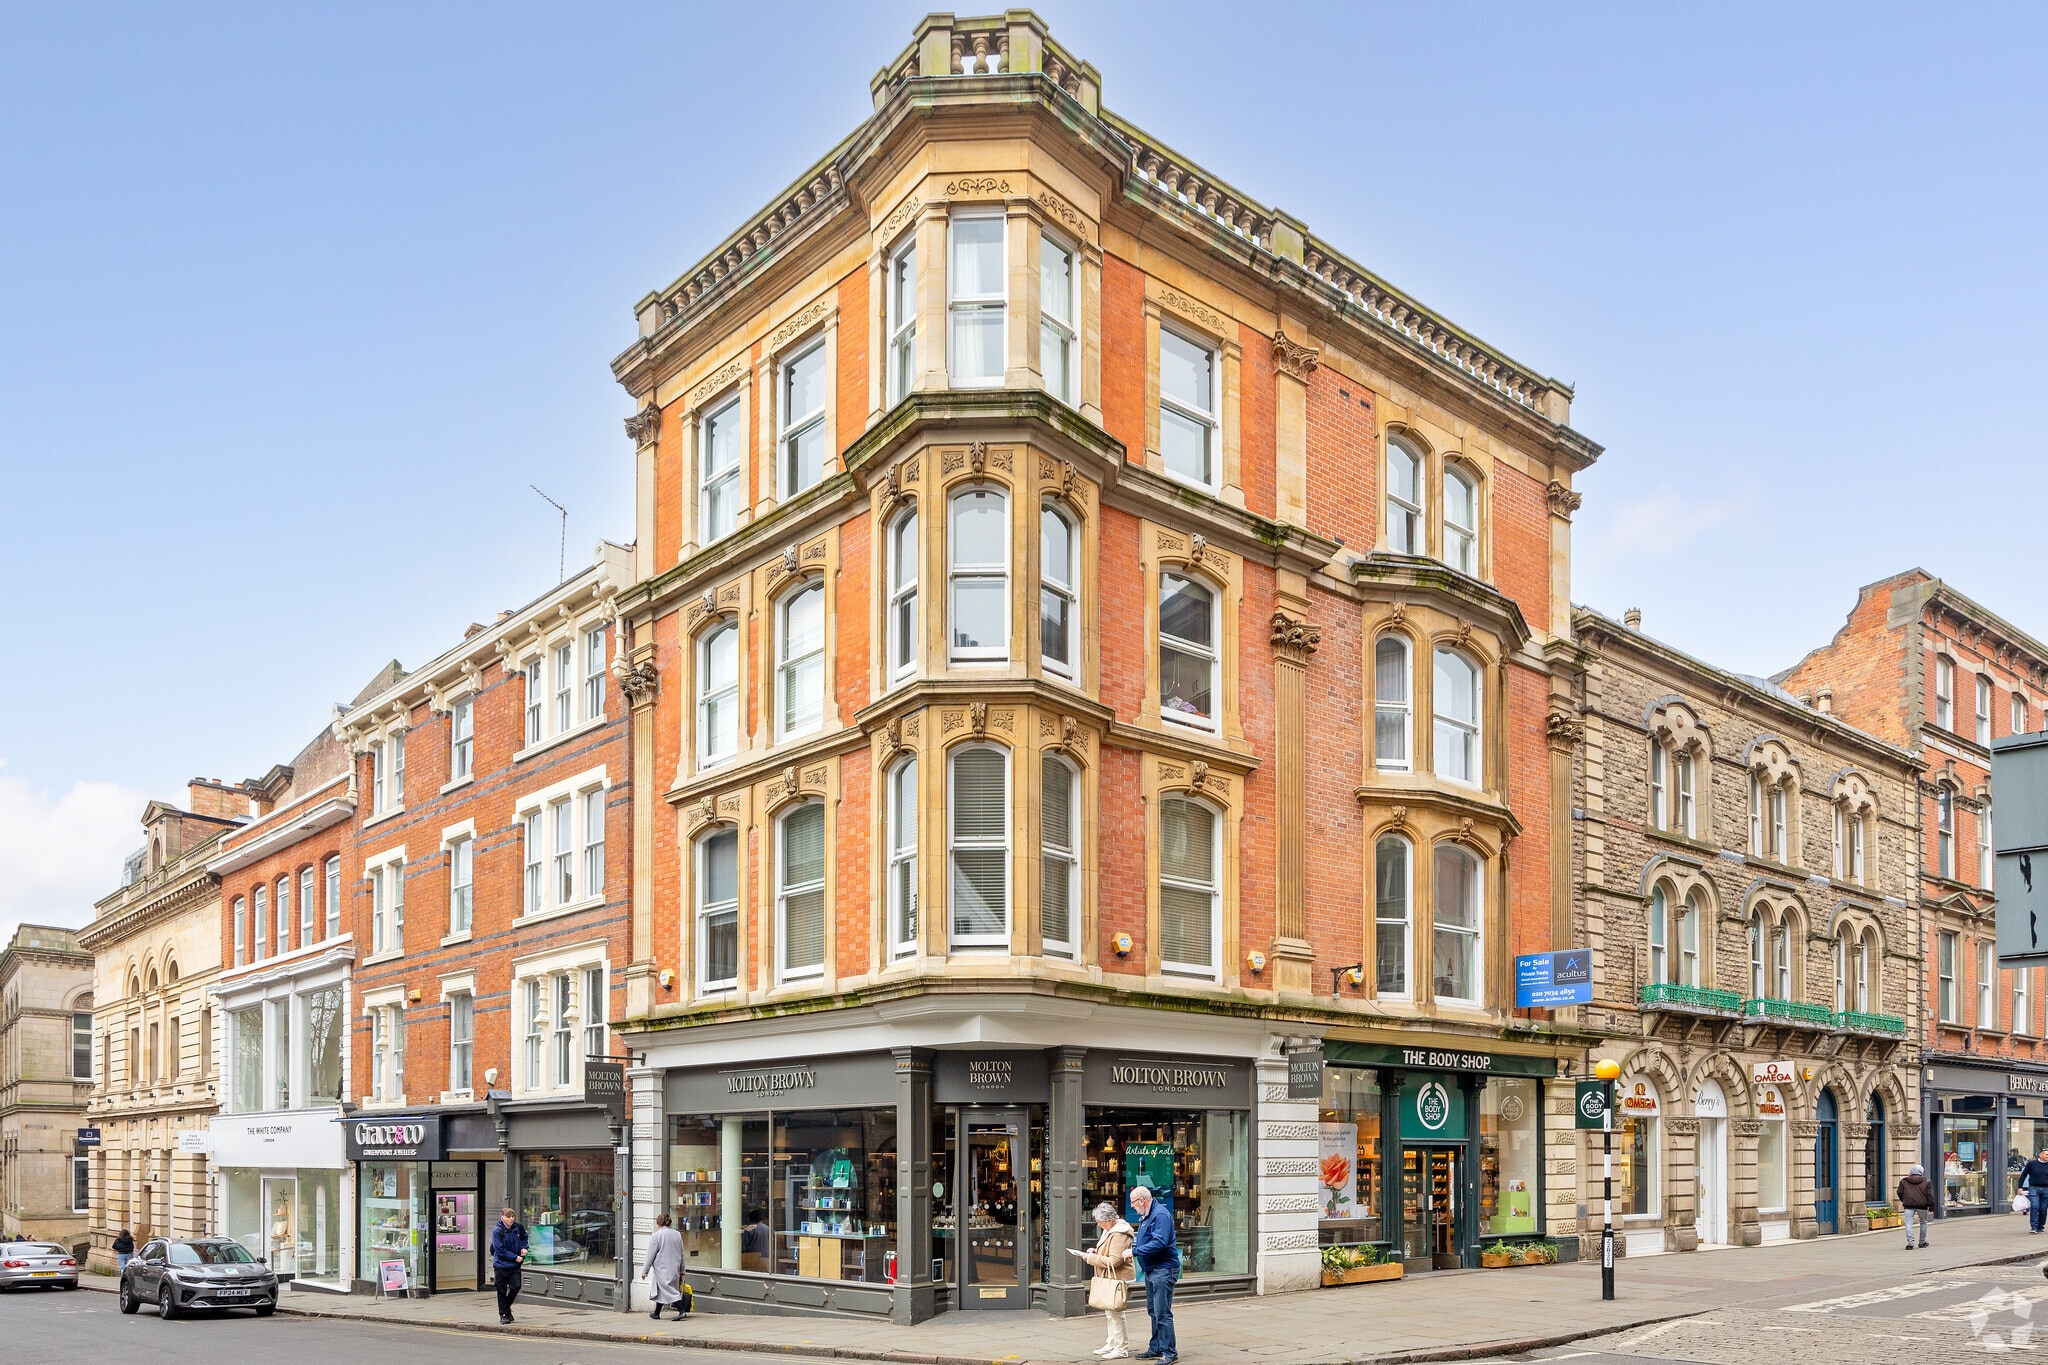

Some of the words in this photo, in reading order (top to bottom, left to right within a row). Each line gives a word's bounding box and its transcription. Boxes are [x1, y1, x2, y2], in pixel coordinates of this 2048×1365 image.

[1532, 958, 1550, 966] Sale
[1557, 970, 1587, 978] acuitus
[1560, 988, 1575, 996] 4850
[1403, 1050, 1426, 1065] THE
[1429, 1052, 1460, 1068] BODY
[970, 1061, 1012, 1071] MOLTON
[1291, 1062, 1320, 1072] MOLTON
[588, 1070, 621, 1080] MOLTON
[970, 1072, 1011, 1082] BROWN
[1112, 1066, 1170, 1085] MOLTON
[1173, 1069, 1226, 1087] BROWN
[1291, 1072, 1318, 1083] BROWN
[1755, 1073, 1792, 1082] OMEGA
[588, 1080, 620, 1090] BROWN
[727, 1074, 768, 1093] MOLTON
[770, 1071, 815, 1090] BROWN
[2010, 1074, 2037, 1090] BERRY'S
[1624, 1097, 1657, 1110] OMEGA
[1696, 1090, 1720, 1111] Berry's
[1760, 1104, 1784, 1114] OMEGA
[247, 1127, 255, 1135] THE
[256, 1127, 270, 1135] WHITE
[270, 1126, 292, 1134] COMPANY
[1126, 1145, 1150, 1155] Artists
[1150, 1146, 1158, 1158] of
[1158, 1146, 1175, 1155] note
[432, 1170, 460, 1178] Grace
